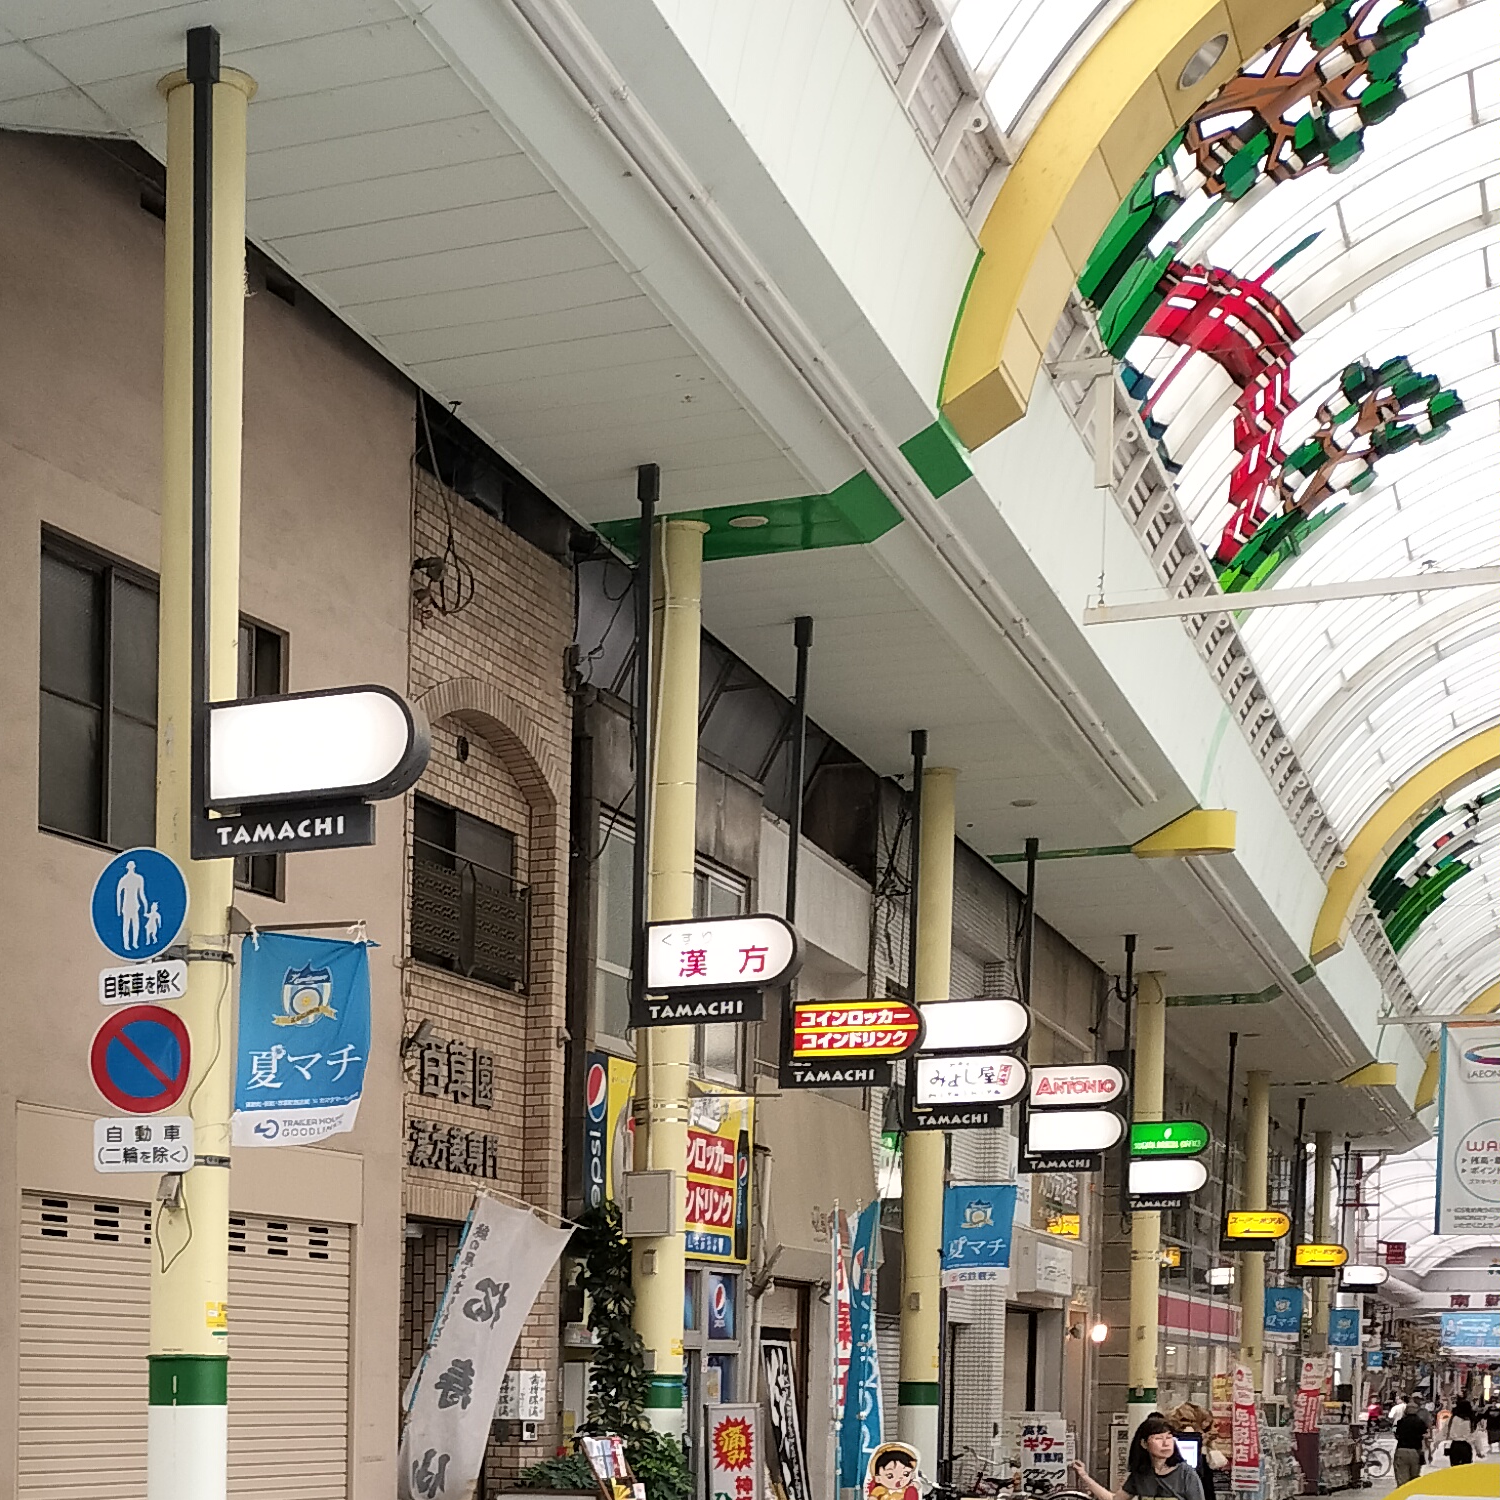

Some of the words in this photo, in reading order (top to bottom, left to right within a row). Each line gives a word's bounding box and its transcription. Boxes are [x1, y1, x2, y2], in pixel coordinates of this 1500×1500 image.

[217, 815, 345, 846] TAMACHI
[678, 945, 769, 978] 漢方
[104, 968, 181, 999] 自転車を除く
[649, 1000, 744, 1019] TAMACHI
[800, 1009, 911, 1027] コインロッカー
[801, 1031, 909, 1049] コインドリンク
[245, 1043, 362, 1091] 夏マチ
[793, 1068, 875, 1083] TAMACHI
[929, 1065, 998, 1088] みよし屋
[1035, 1077, 1116, 1096] ANTONIO
[282, 1118, 318, 1128] TRAILER
[917, 1113, 988, 1126] TAMACHI
[105, 1124, 182, 1144] 自動車
[1466, 1139, 1500, 1152] WA
[97, 1145, 189, 1166] (二輪を除く)
[686, 1136, 735, 1176] ンロッカー
[1030, 1159, 1092, 1170] TAMACHI
[587, 1130, 605, 1210] epsi
[685, 1186, 734, 1225] ンドリンク
[1129, 1199, 1182, 1209] TAMACHI
[719, 1425, 748, 1465] 痛み
[1023, 1436, 1066, 1453] ギター
[1022, 1468, 1066, 1480] クラシック
